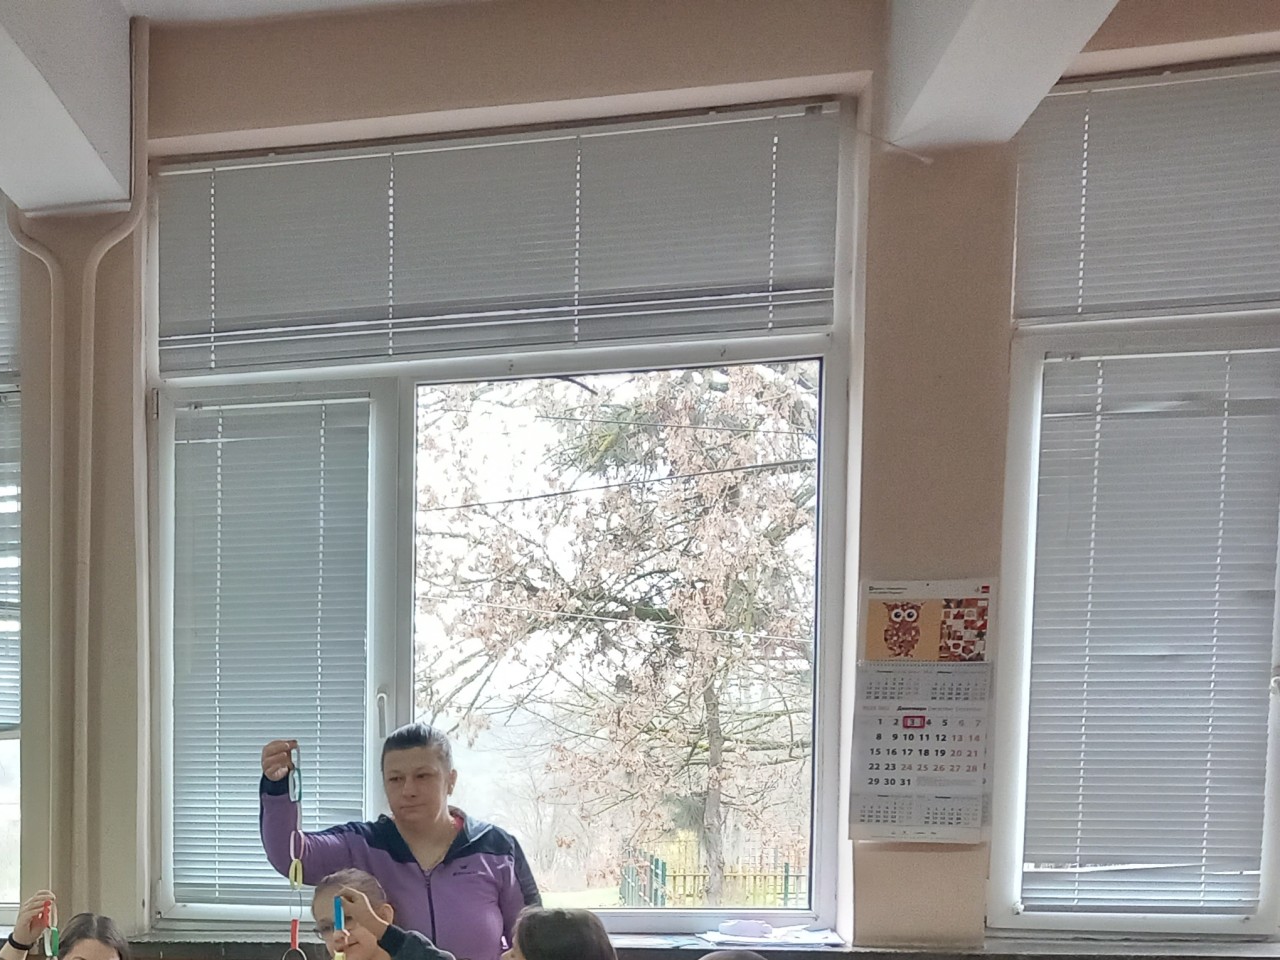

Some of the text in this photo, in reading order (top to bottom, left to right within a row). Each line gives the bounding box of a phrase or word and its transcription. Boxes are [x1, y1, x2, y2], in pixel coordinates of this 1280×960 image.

[976, 720, 981, 728] 7
[884, 762, 896, 770] 23
[966, 764, 978, 772] 28
[884, 778, 896, 786] 30
